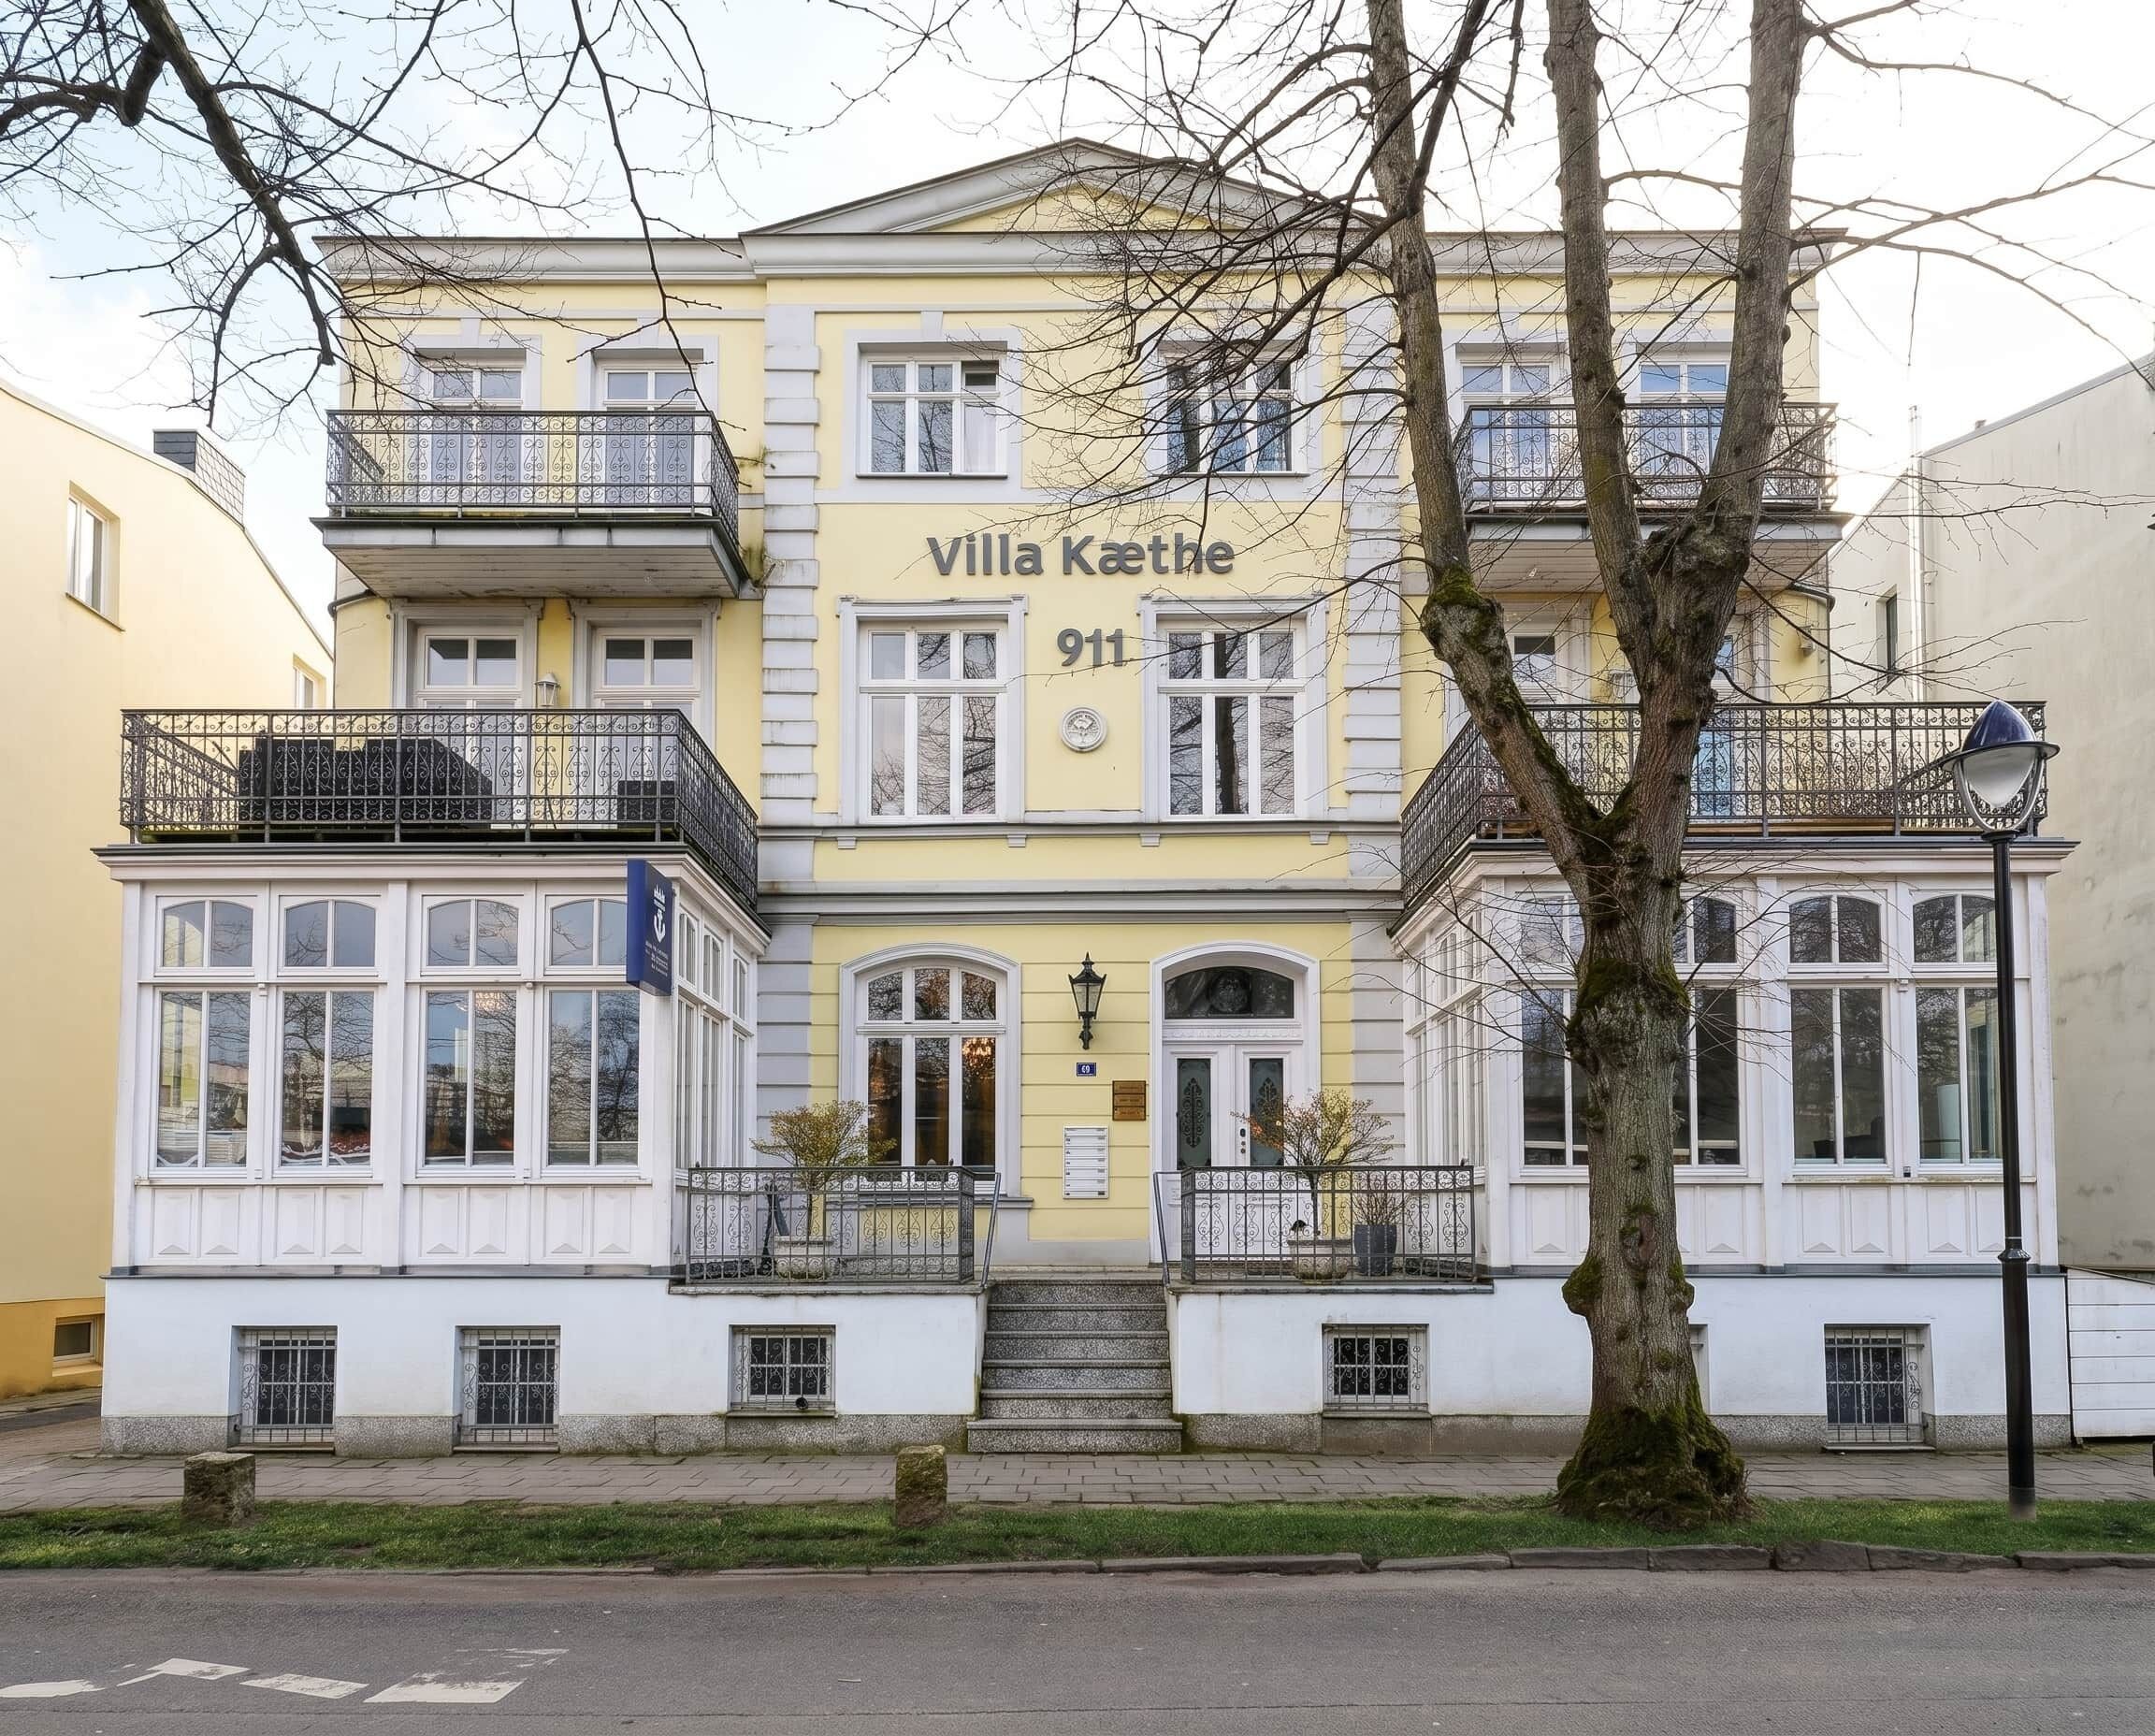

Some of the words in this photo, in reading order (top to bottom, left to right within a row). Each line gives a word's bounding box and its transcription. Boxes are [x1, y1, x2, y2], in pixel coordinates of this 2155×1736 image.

[927, 532, 1044, 575] Villa
[1063, 532, 1235, 574] Kæthe
[1057, 628, 1126, 667] 911
